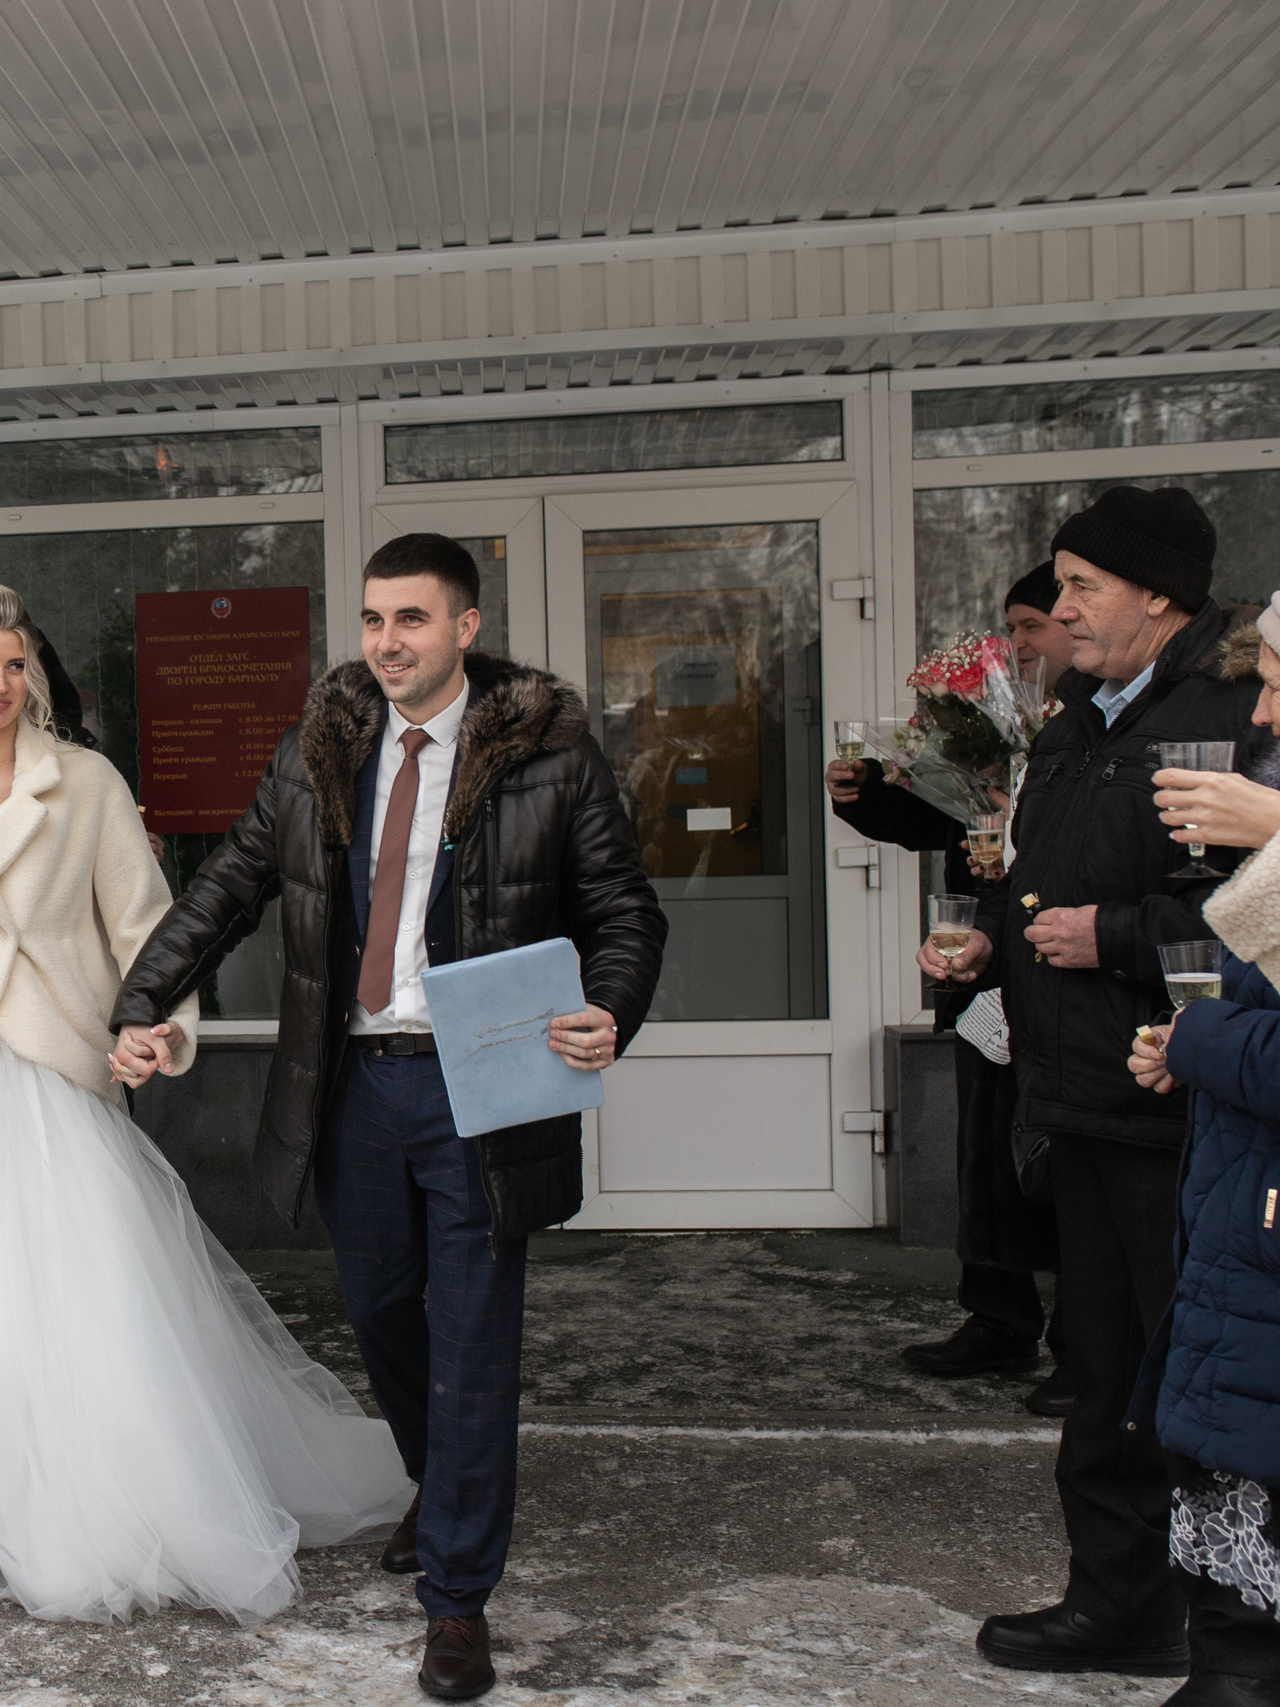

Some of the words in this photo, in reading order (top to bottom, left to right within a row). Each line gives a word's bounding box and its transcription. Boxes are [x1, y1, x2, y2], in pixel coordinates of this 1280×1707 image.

[145, 635, 191, 643] УПРАВЛЕНИЕ
[194, 633, 231, 641] ЮСТИЦИИ
[232, 631, 280, 640] АЛТАЙСКОГО
[282, 630, 301, 638] КРАЯ
[189, 653, 223, 663] ОТДЕЛ
[226, 652, 250, 662] ЗАГС
[155, 665, 197, 676] ДВОРЕЦ
[199, 662, 292, 674] БРАКОСОЧЕТАНИЯ
[167, 676, 183, 686] ПО
[185, 675, 226, 685] ГОРОДУ
[228, 673, 280, 683] БАРНАУЛУ
[192, 703, 221, 711] РЕЖИМ
[223, 702, 256, 710] РАБОТЫ:
[151, 719, 184, 727] Вторник
[190, 718, 222, 726] пятница
[245, 715, 263, 723] 8.00
[277, 714, 299, 722] 17.00
[151, 730, 178, 739] Приём
[179, 729, 214, 738] граждан
[245, 727, 263, 735] 8.00
[152, 745, 184, 755] Суббота
[246, 742, 264, 750] 8.00
[153, 757, 179, 766] Приём
[181, 756, 216, 765] граждан
[246, 754, 264, 762] 8.00
[153, 773, 188, 781] Перерыв
